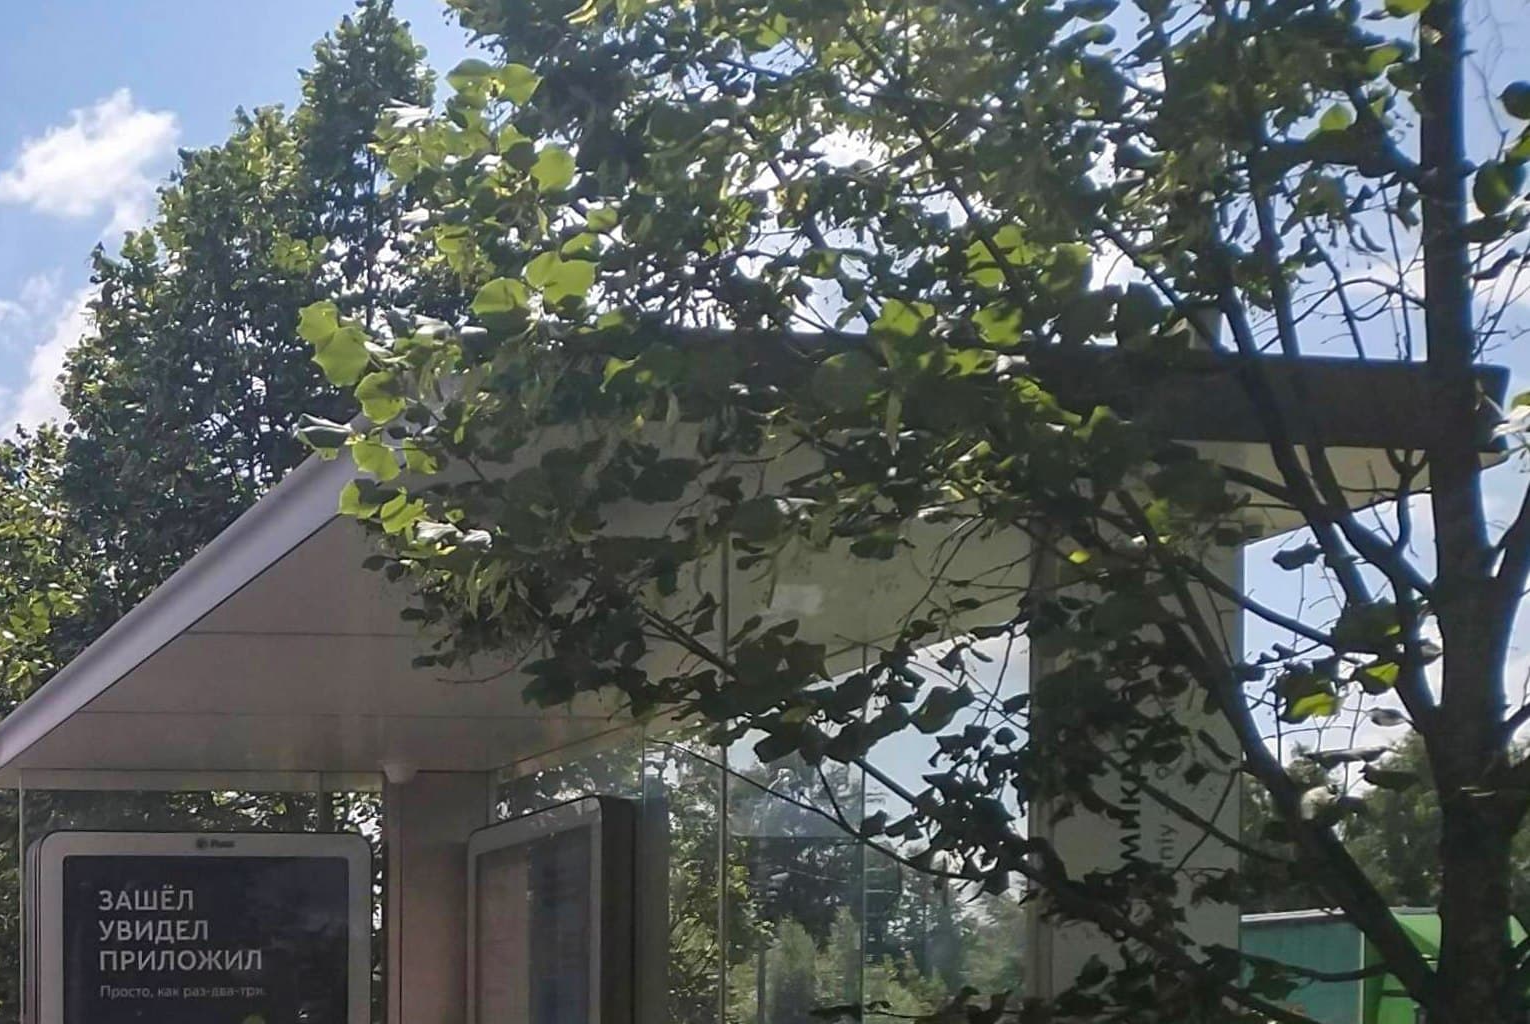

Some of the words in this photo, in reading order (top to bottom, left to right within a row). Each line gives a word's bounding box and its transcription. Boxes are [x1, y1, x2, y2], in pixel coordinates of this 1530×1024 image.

[98, 884, 194, 911] ЗАШЁЛ
[98, 919, 209, 945] УВИДЕЛ
[99, 949, 263, 971] ПРИЛОЖИЛ
[100, 985, 154, 999] Просто,
[157, 986, 178, 998] как
